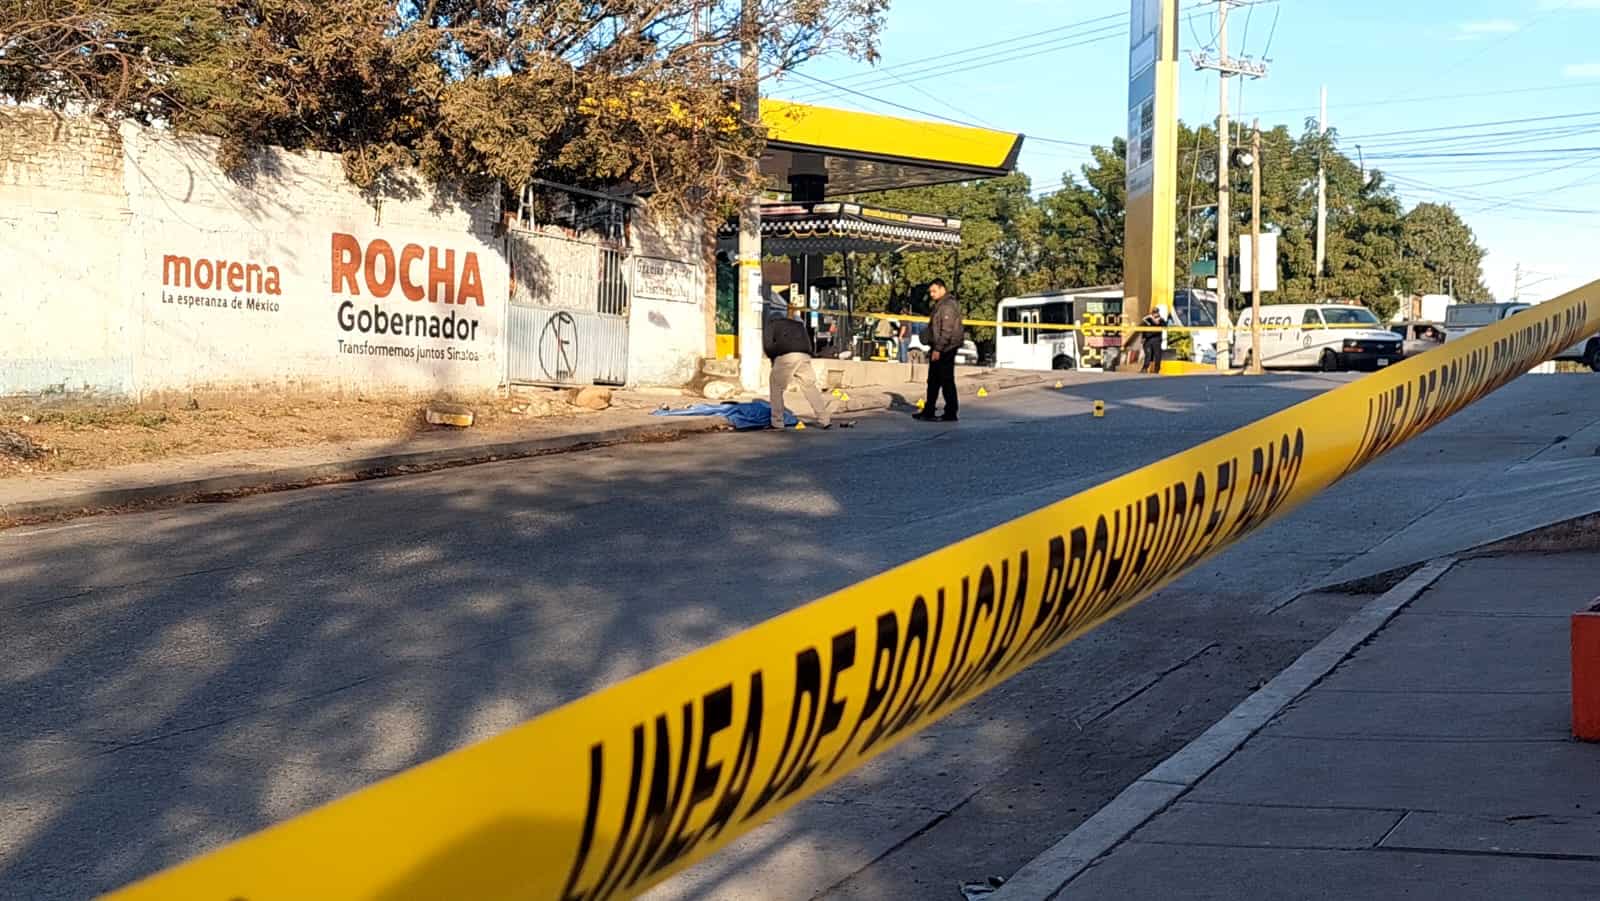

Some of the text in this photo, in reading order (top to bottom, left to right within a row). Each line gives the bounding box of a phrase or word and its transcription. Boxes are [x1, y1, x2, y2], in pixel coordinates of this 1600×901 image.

[163, 254, 282, 295] morena
[332, 232, 485, 306] ROCHA
[162, 290, 174, 303] La
[177, 294, 228, 308] esperanza
[231, 296, 242, 309] de
[337, 300, 479, 341] Gobernador
[338, 339, 415, 358] Transformemos
[416, 344, 445, 363] juntos
[739, 626, 856, 824] DE
[822, 550, 1028, 774] POLICIA
